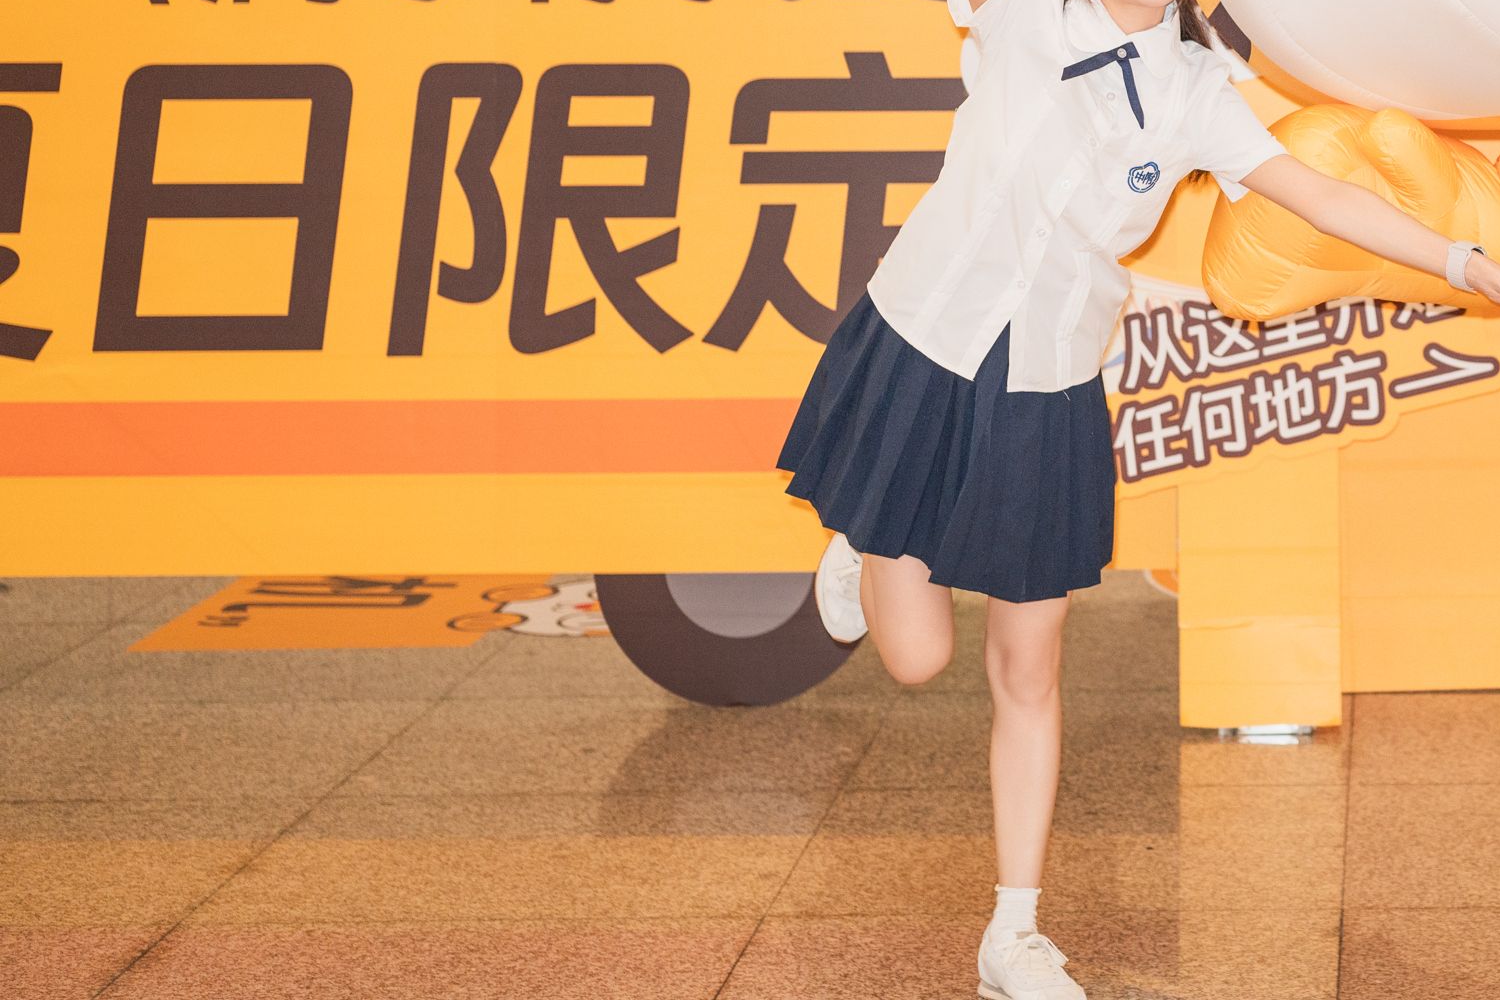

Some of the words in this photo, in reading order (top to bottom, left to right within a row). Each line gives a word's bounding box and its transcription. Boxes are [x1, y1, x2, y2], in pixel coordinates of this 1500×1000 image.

[0, 51, 969, 362] 日限定
[1114, 350, 1387, 482] 任何地方
